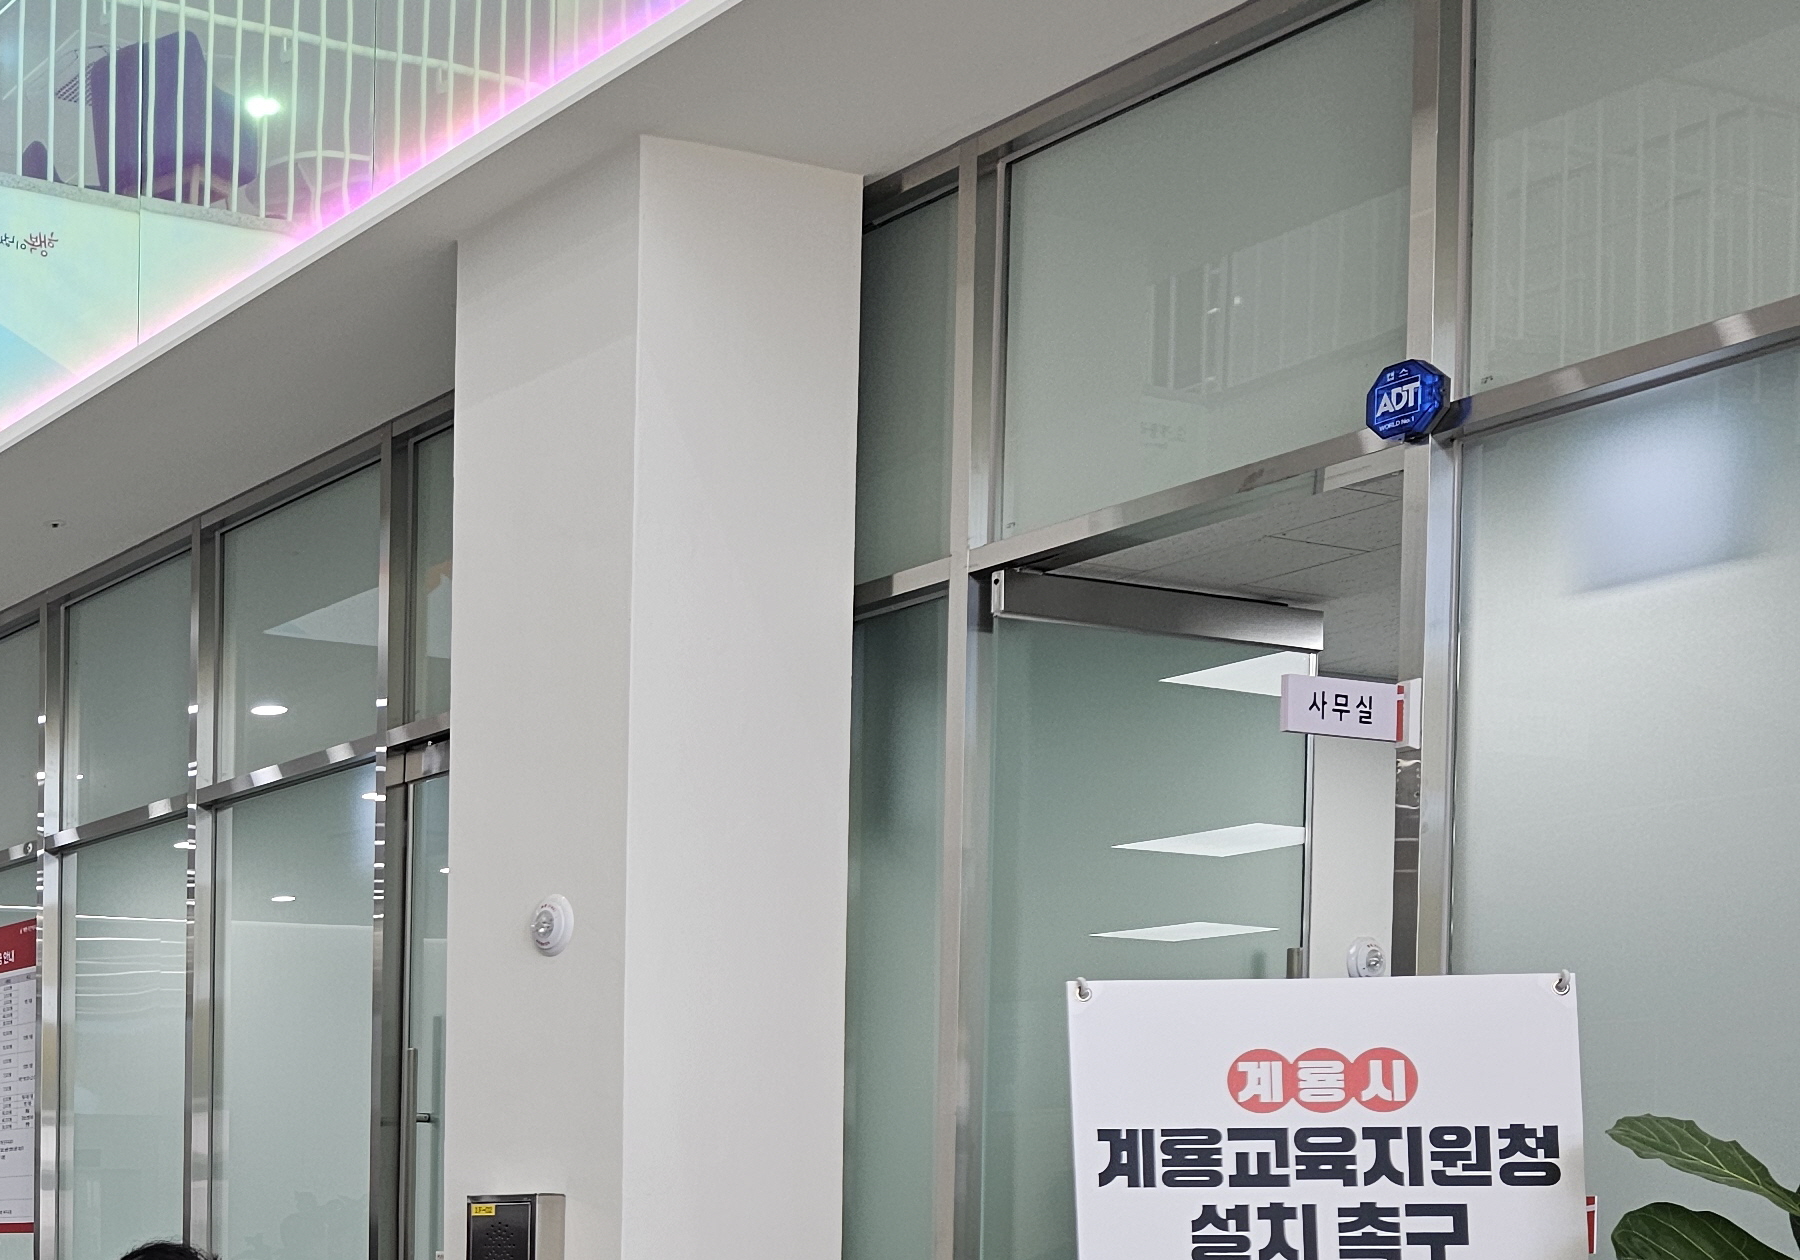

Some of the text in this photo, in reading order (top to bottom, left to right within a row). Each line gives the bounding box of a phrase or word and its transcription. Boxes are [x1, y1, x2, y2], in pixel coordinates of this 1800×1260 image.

[1376, 381, 1420, 418] ADT
[1379, 421, 1401, 431] WORLD
[1308, 690, 1373, 725] 사무실
[1236, 1059, 1406, 1103] 계룡시
[1096, 1124, 1561, 1188] 계룡교육지원청
